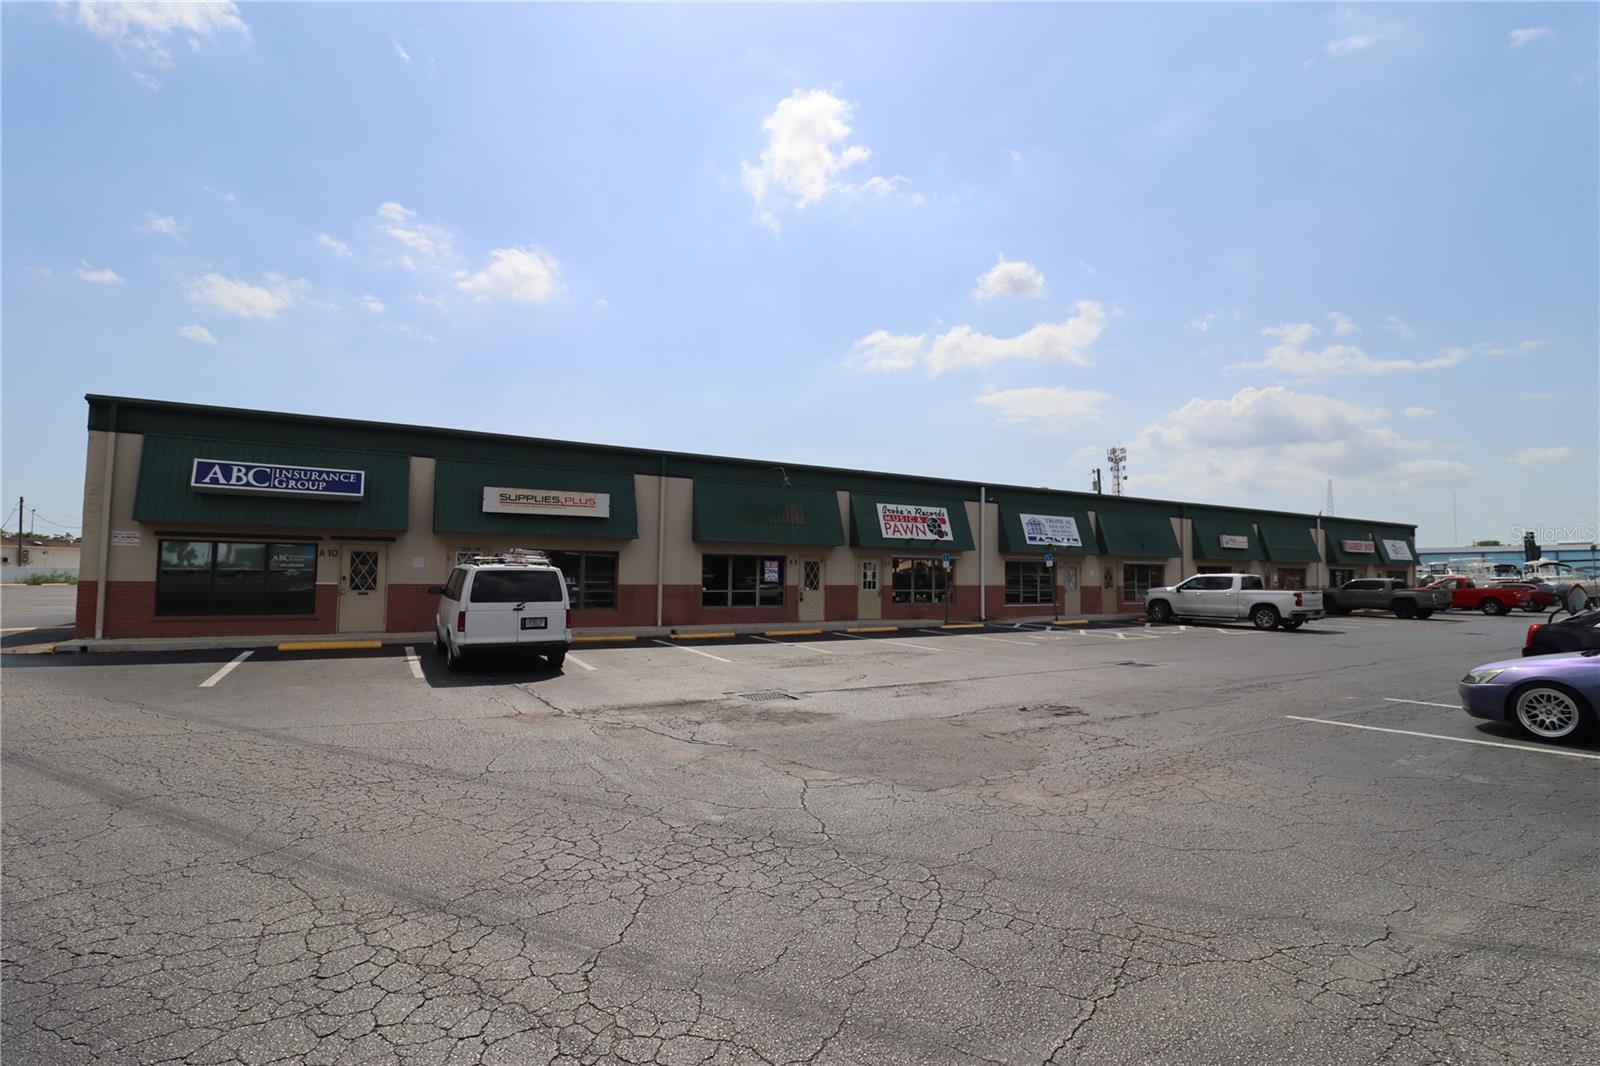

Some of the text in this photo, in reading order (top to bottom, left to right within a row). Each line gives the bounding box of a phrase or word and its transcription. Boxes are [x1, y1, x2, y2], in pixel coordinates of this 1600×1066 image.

[202, 464, 357, 487] ABC INSURANCE
[274, 478, 326, 490] GROUP
[499, 493, 596, 505] SUPPLIES PLUS
[914, 507, 945, 517] Records
[884, 522, 927, 537] PAWN
[328, 549, 338, 557] 10
